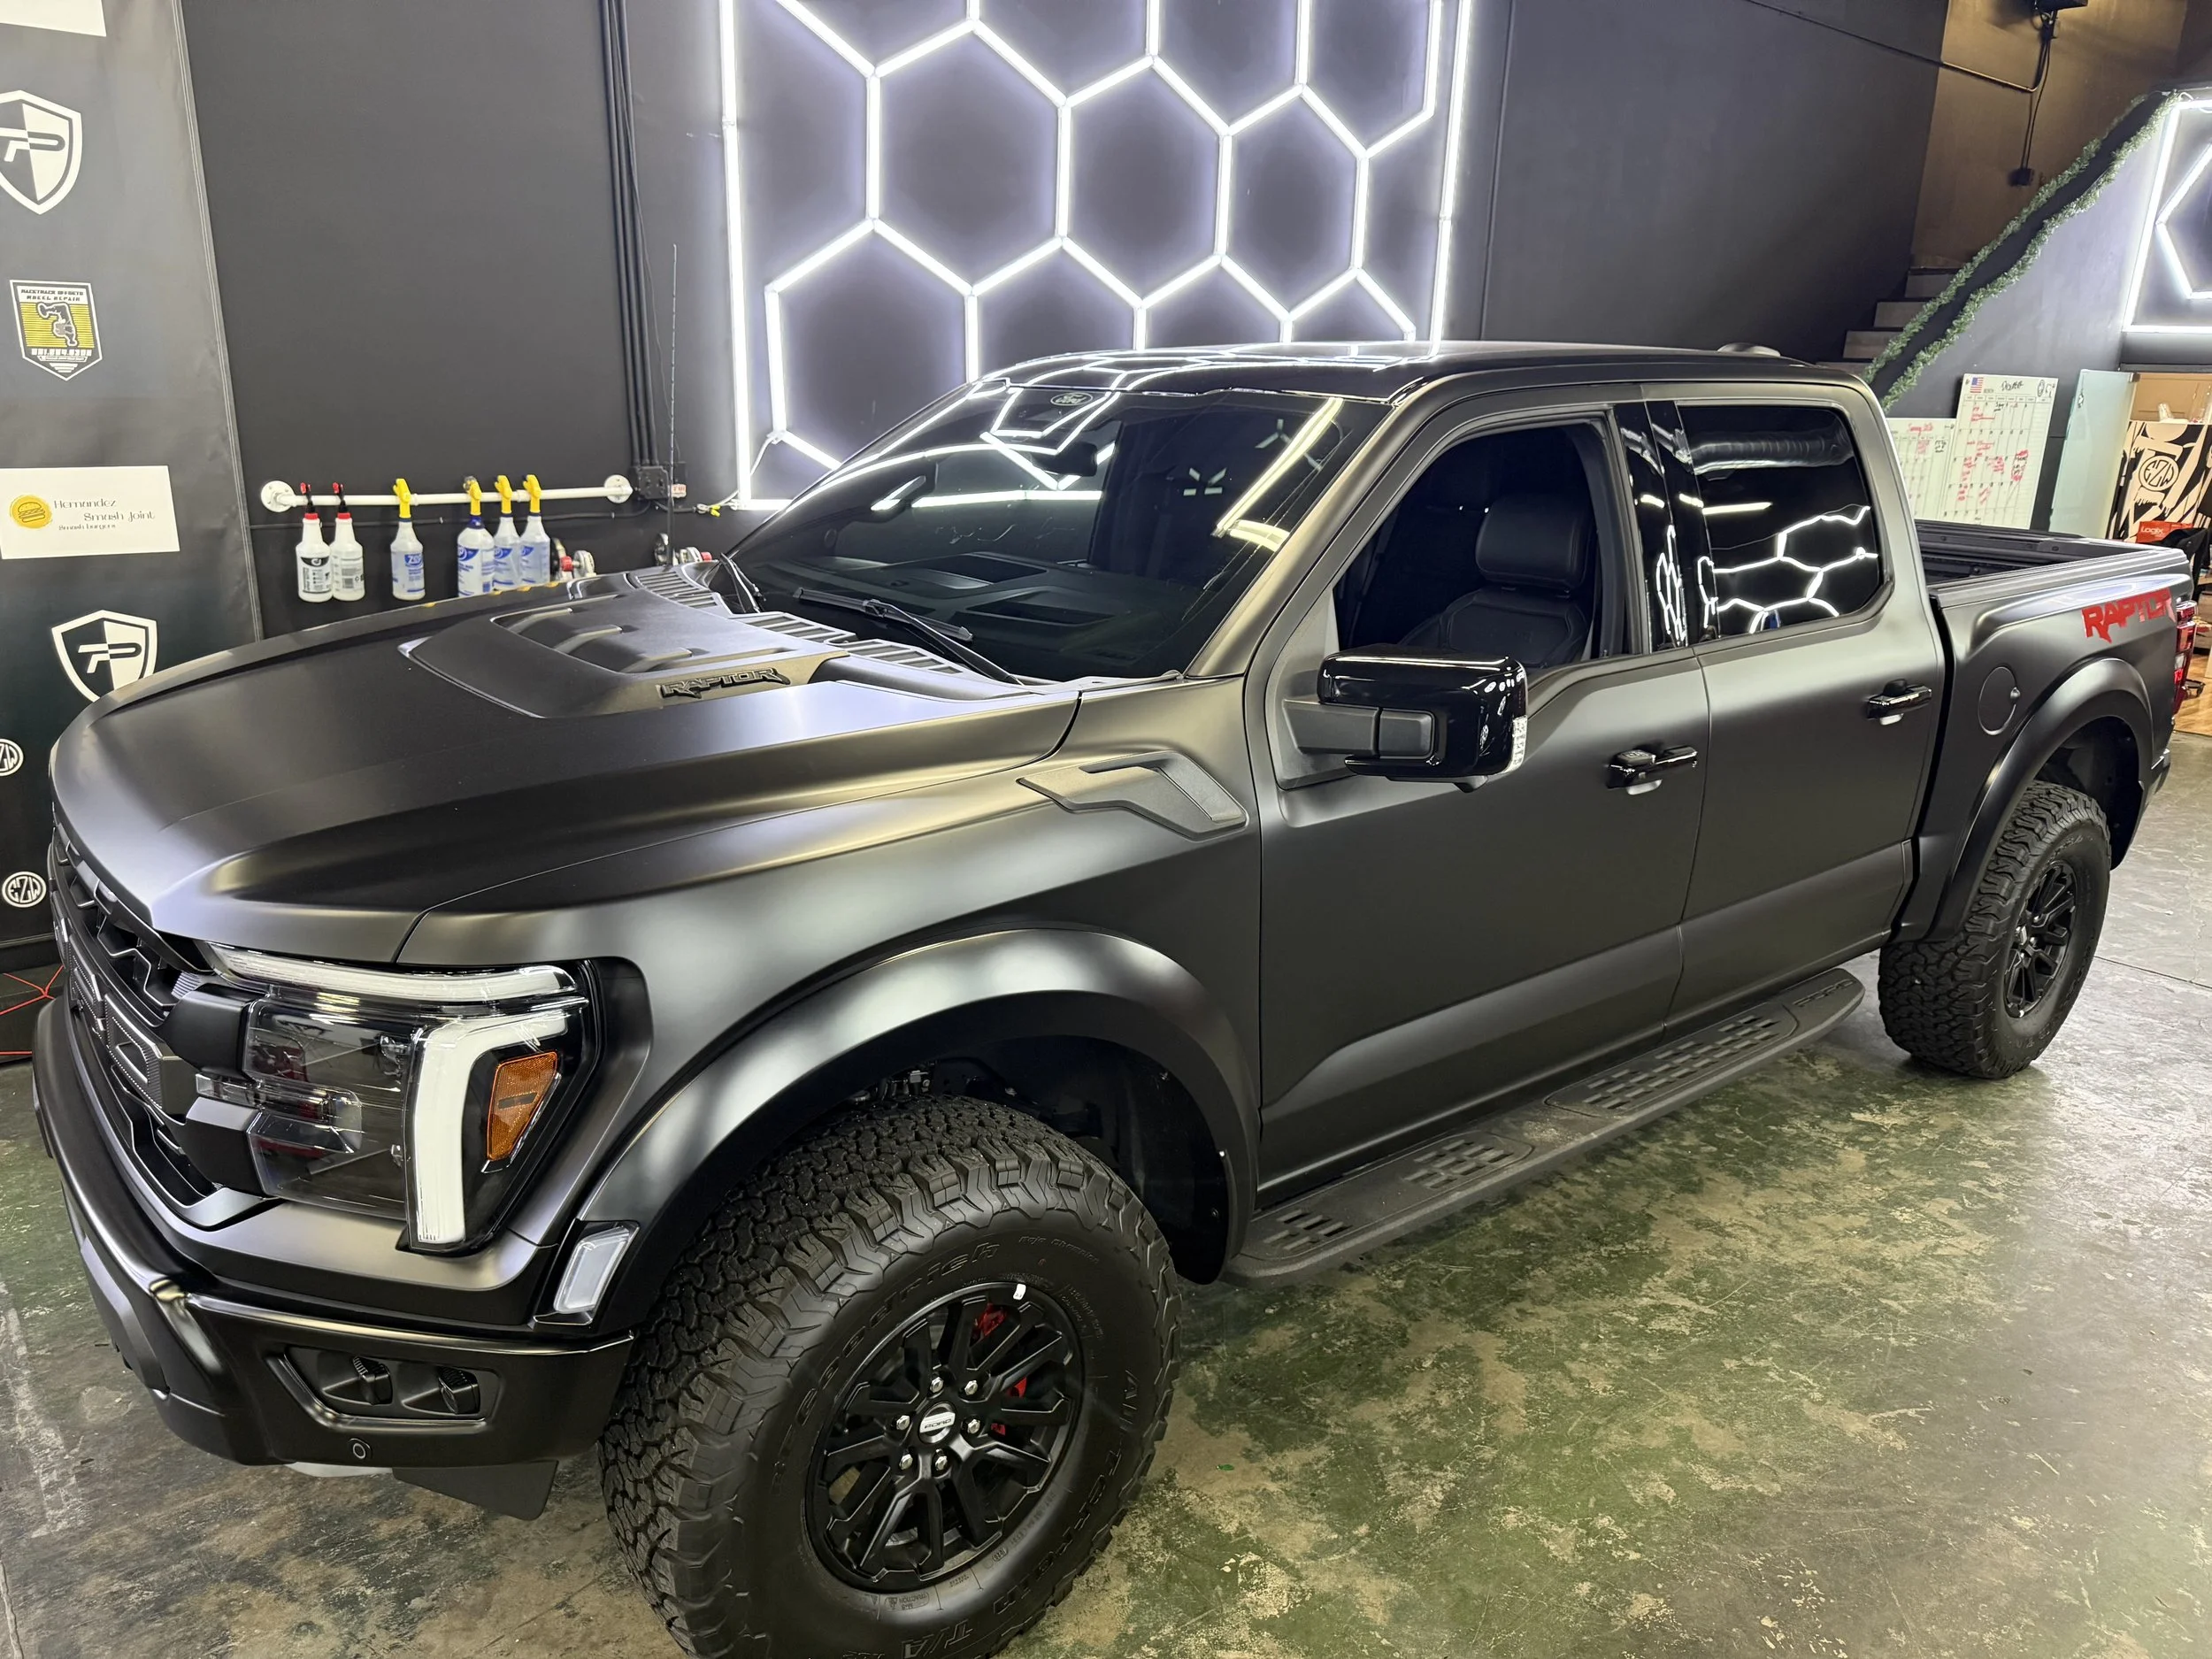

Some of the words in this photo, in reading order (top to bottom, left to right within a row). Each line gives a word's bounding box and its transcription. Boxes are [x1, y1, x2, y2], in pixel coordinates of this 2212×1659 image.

[54, 498, 116, 509] Hernandez
[83, 511, 124, 521] Smash
[2081, 587, 2177, 644] RAPTOR
[661, 668, 791, 700] RAPTOR
[924, 1418, 952, 1429] FORD
